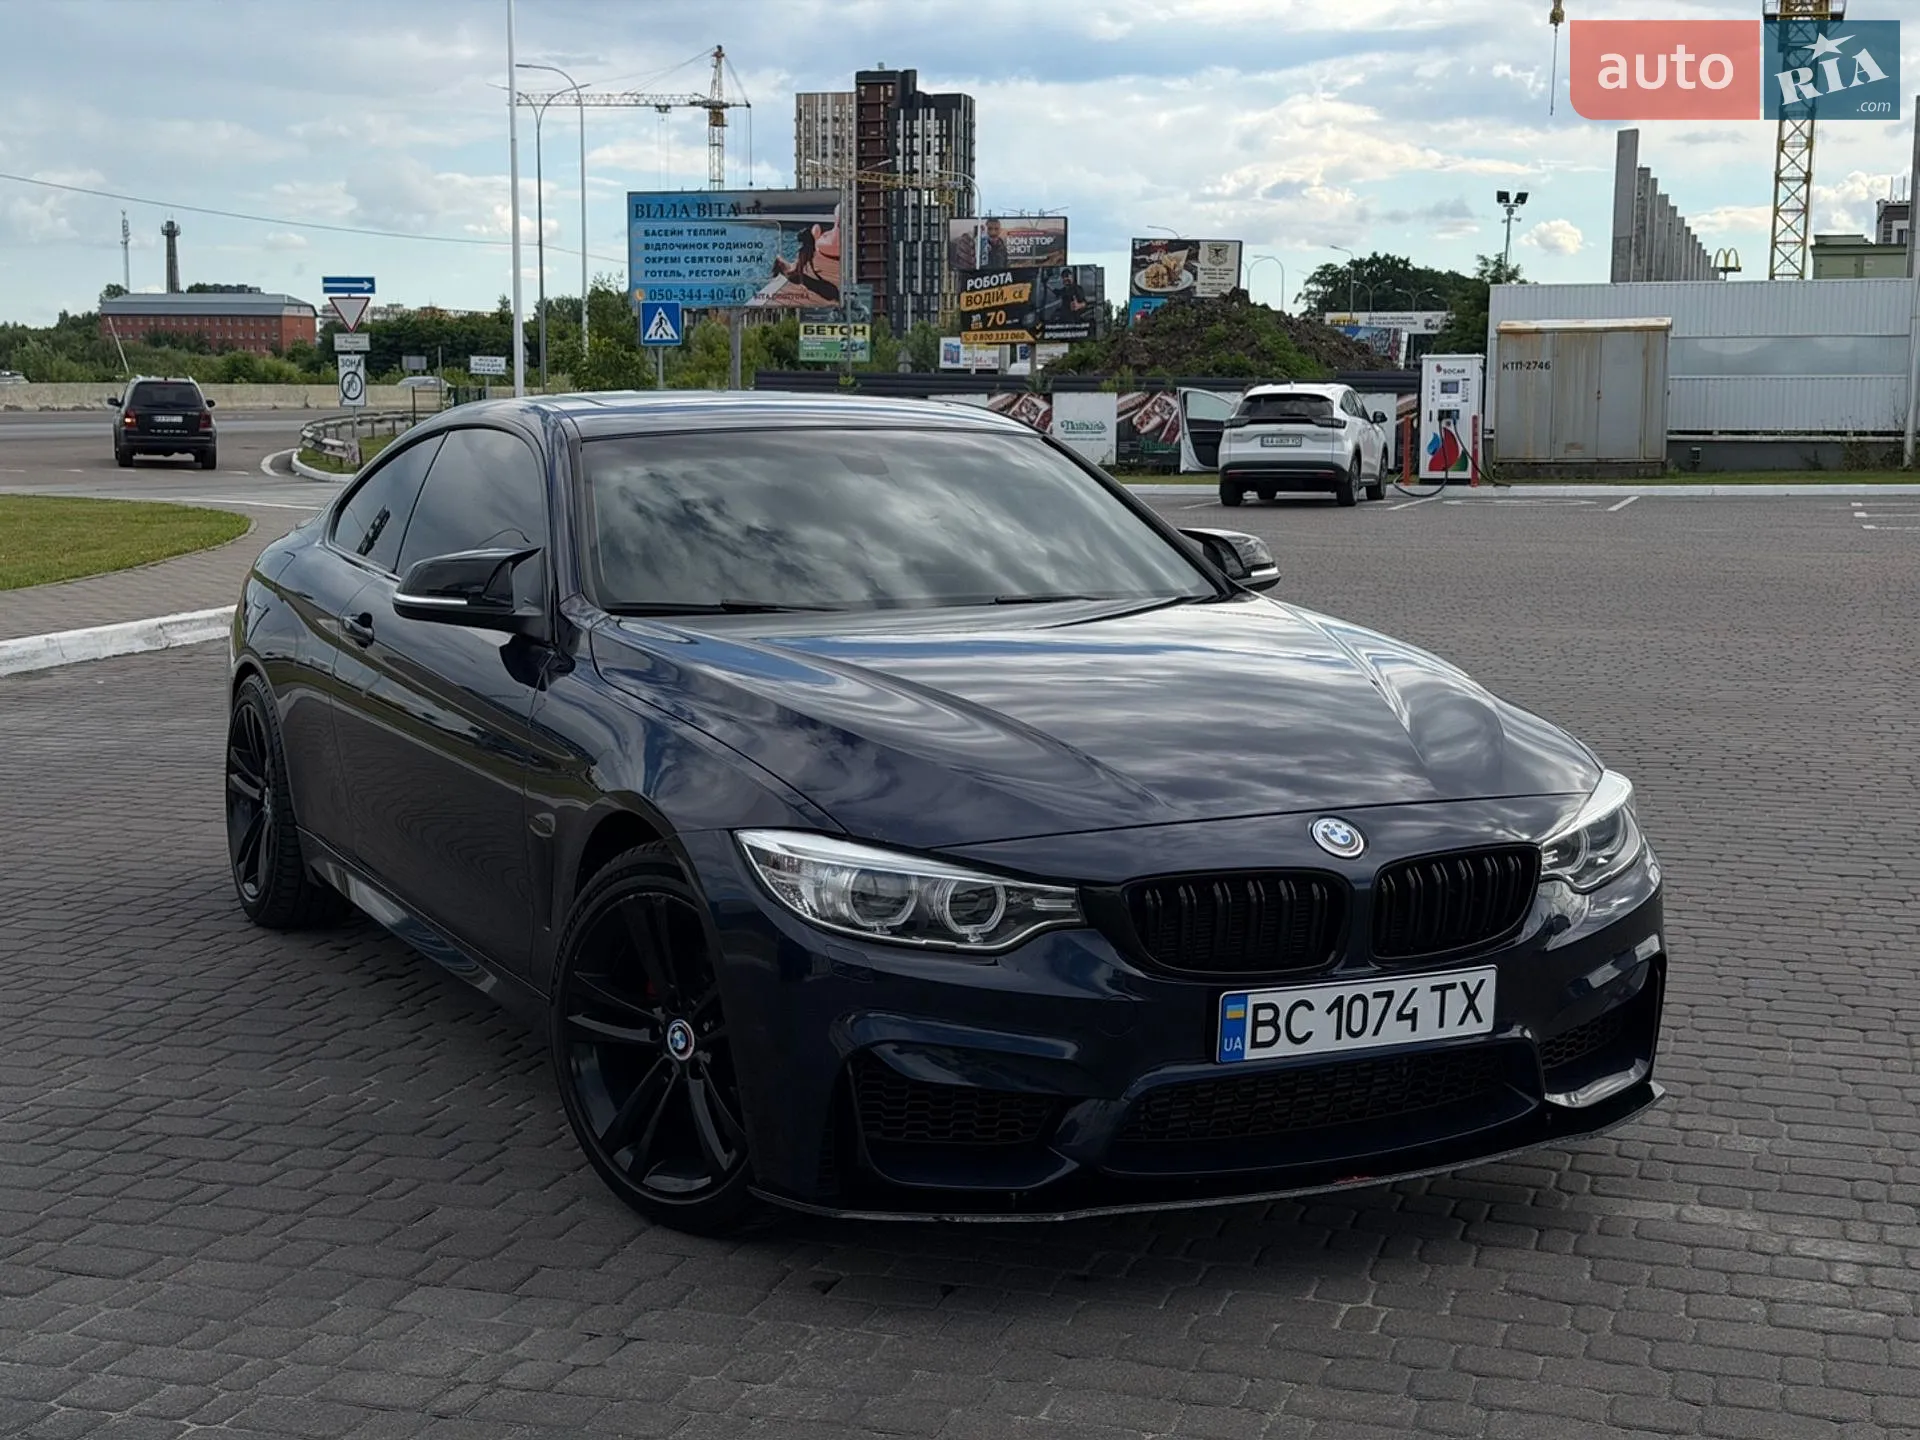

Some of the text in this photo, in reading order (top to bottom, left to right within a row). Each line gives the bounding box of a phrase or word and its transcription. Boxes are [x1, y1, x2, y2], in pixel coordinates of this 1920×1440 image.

[634, 203, 691, 219] ВІЛЛА
[696, 202, 738, 218] ВІТА
[643, 227, 728, 238] БАСЕЙН ТЕПЛИЙ
[643, 241, 764, 251] ВІДПОЧИНОК РОДИНОЮ
[1006, 235, 1053, 246] NON STOP
[1006, 245, 1032, 254] SHOT
[643, 255, 764, 264] ОКРЕМІ СВЯТКОВІ ЗАЛИ
[643, 268, 741, 279] ГОТЕЛЬ, РЕСТОРАН
[966, 271, 1013, 291] РОБОТА
[650, 287, 746, 302] 050-344-40-40
[964, 288, 1008, 308] ВОДІЙ,
[986, 310, 1007, 328] 70
[804, 325, 866, 336] БЕТОН
[1502, 361, 1551, 371] КТП-2746
[1250, 979, 1486, 1049] BC 1074 TX
[1223, 1038, 1243, 1051] UA
